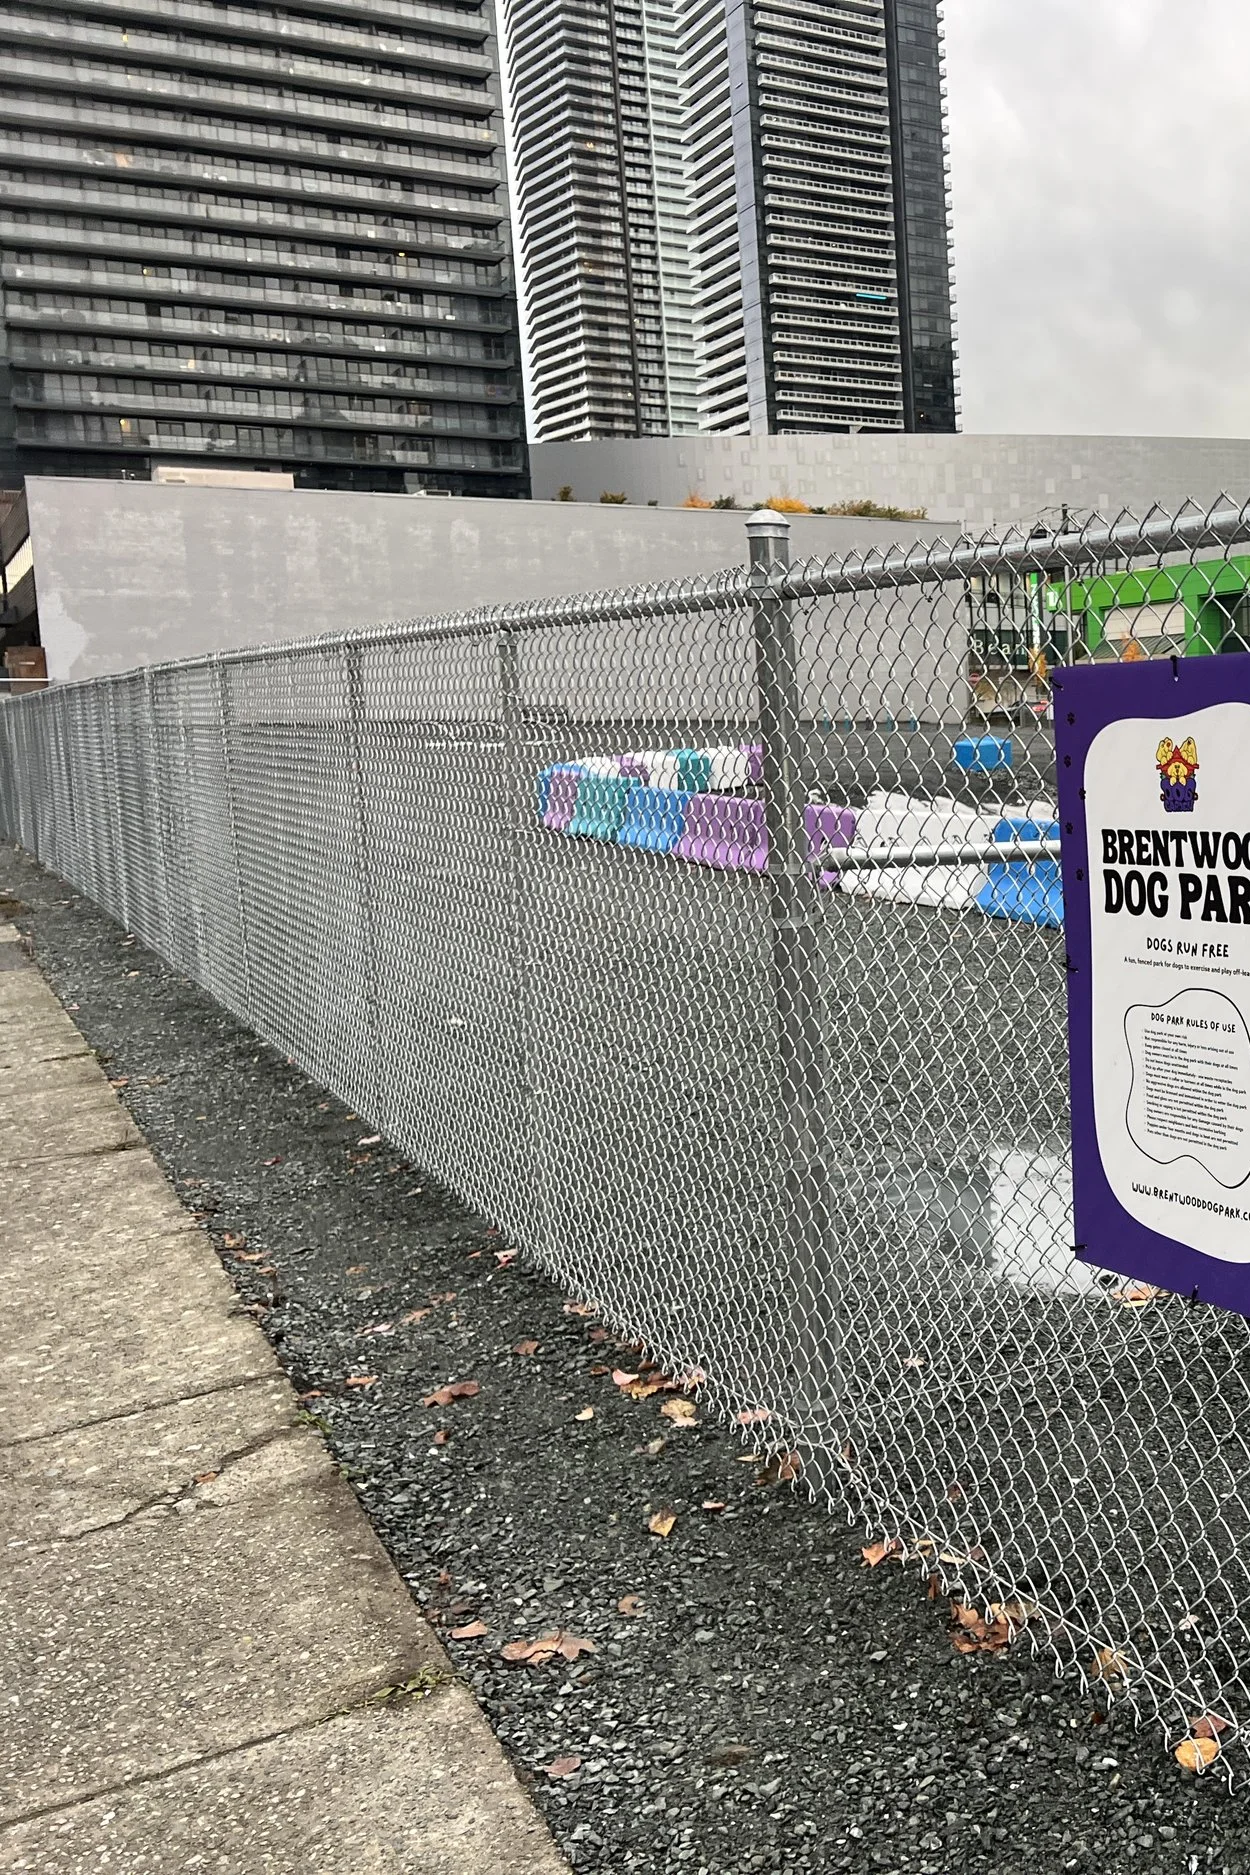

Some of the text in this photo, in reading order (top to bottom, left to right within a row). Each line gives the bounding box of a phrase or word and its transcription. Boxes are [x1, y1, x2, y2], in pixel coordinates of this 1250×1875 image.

[1102, 868, 1170, 919] DOG
[1146, 936, 1229, 958] DOGS RUN FREE
[1153, 959, 1164, 968] park
[1172, 962, 1184, 971] dogs
[1190, 965, 1210, 973] exercise
[1221, 967, 1232, 976] play
[1150, 1012, 1236, 1033] DOG PARK RULES OF USE
